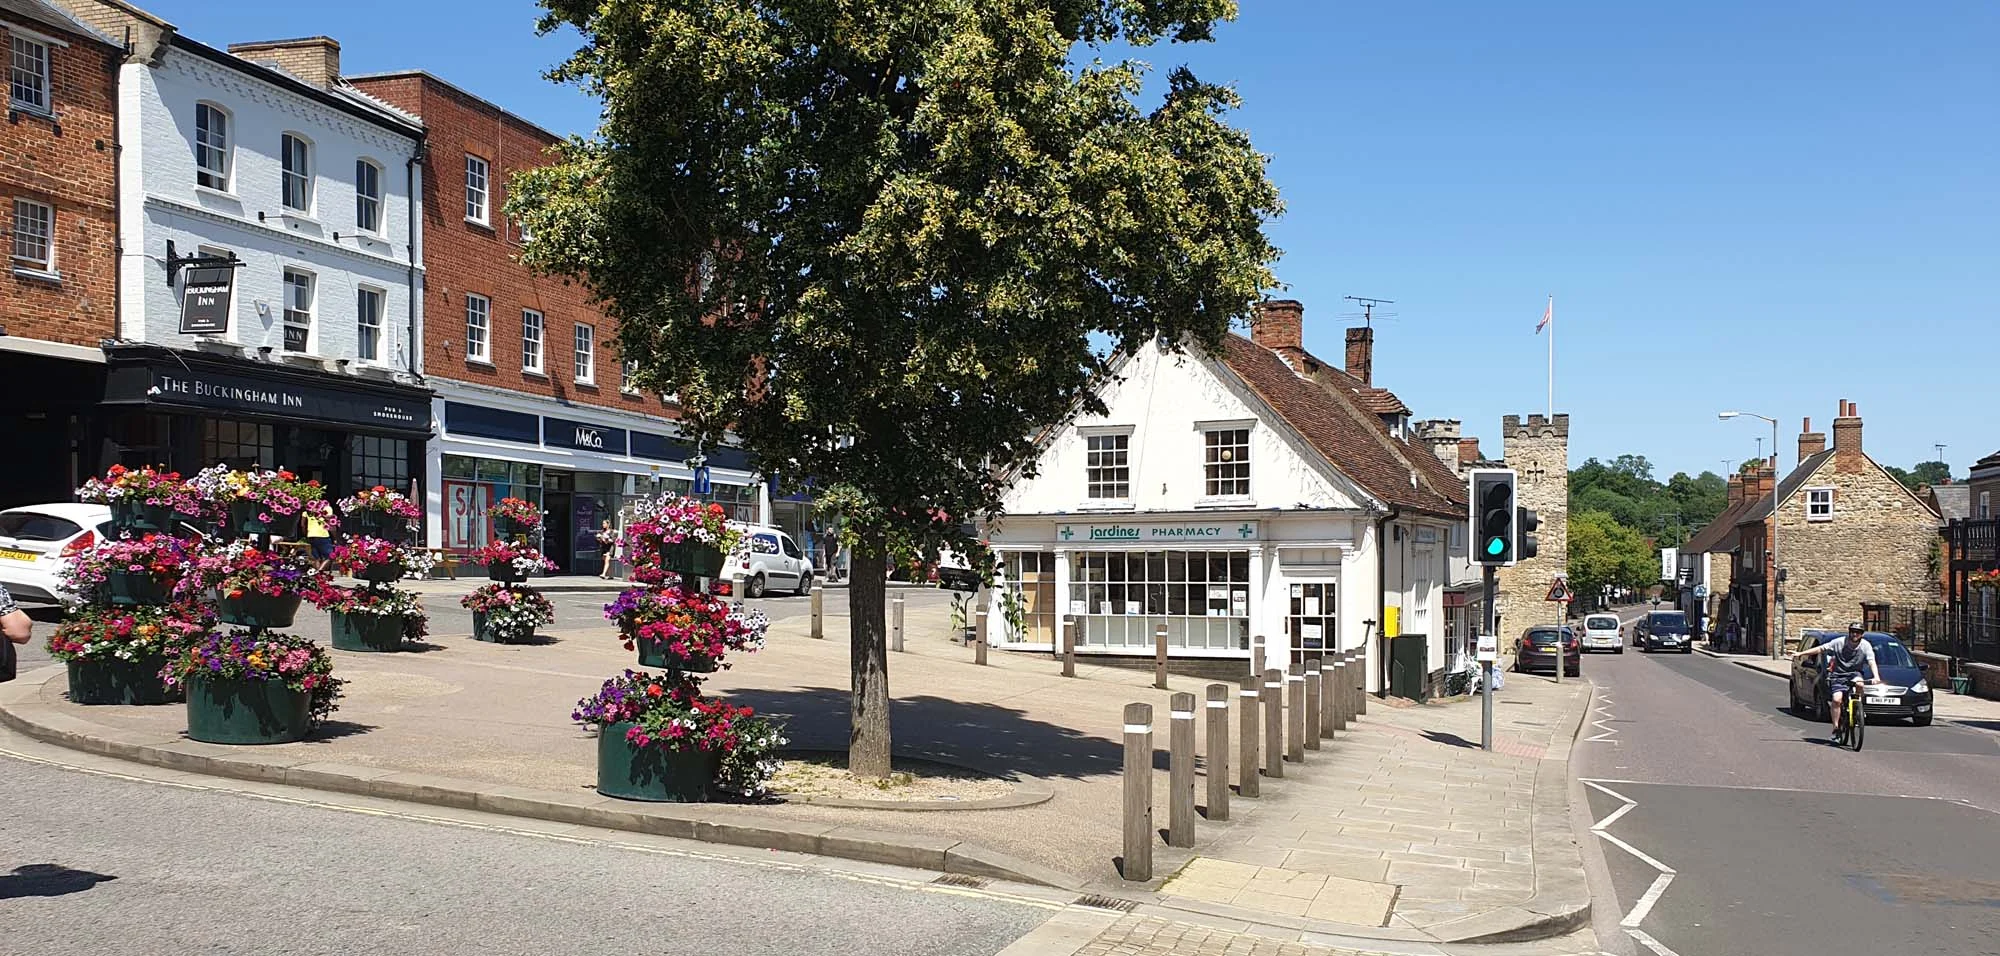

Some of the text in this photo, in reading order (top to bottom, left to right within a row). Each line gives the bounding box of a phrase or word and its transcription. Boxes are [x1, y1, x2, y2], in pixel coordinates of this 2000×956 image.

[197, 295, 215, 306] INN
[161, 375, 303, 407] THE BUCKINGHAM INN
[1089, 525, 1221, 540] jardines PHARMACY
